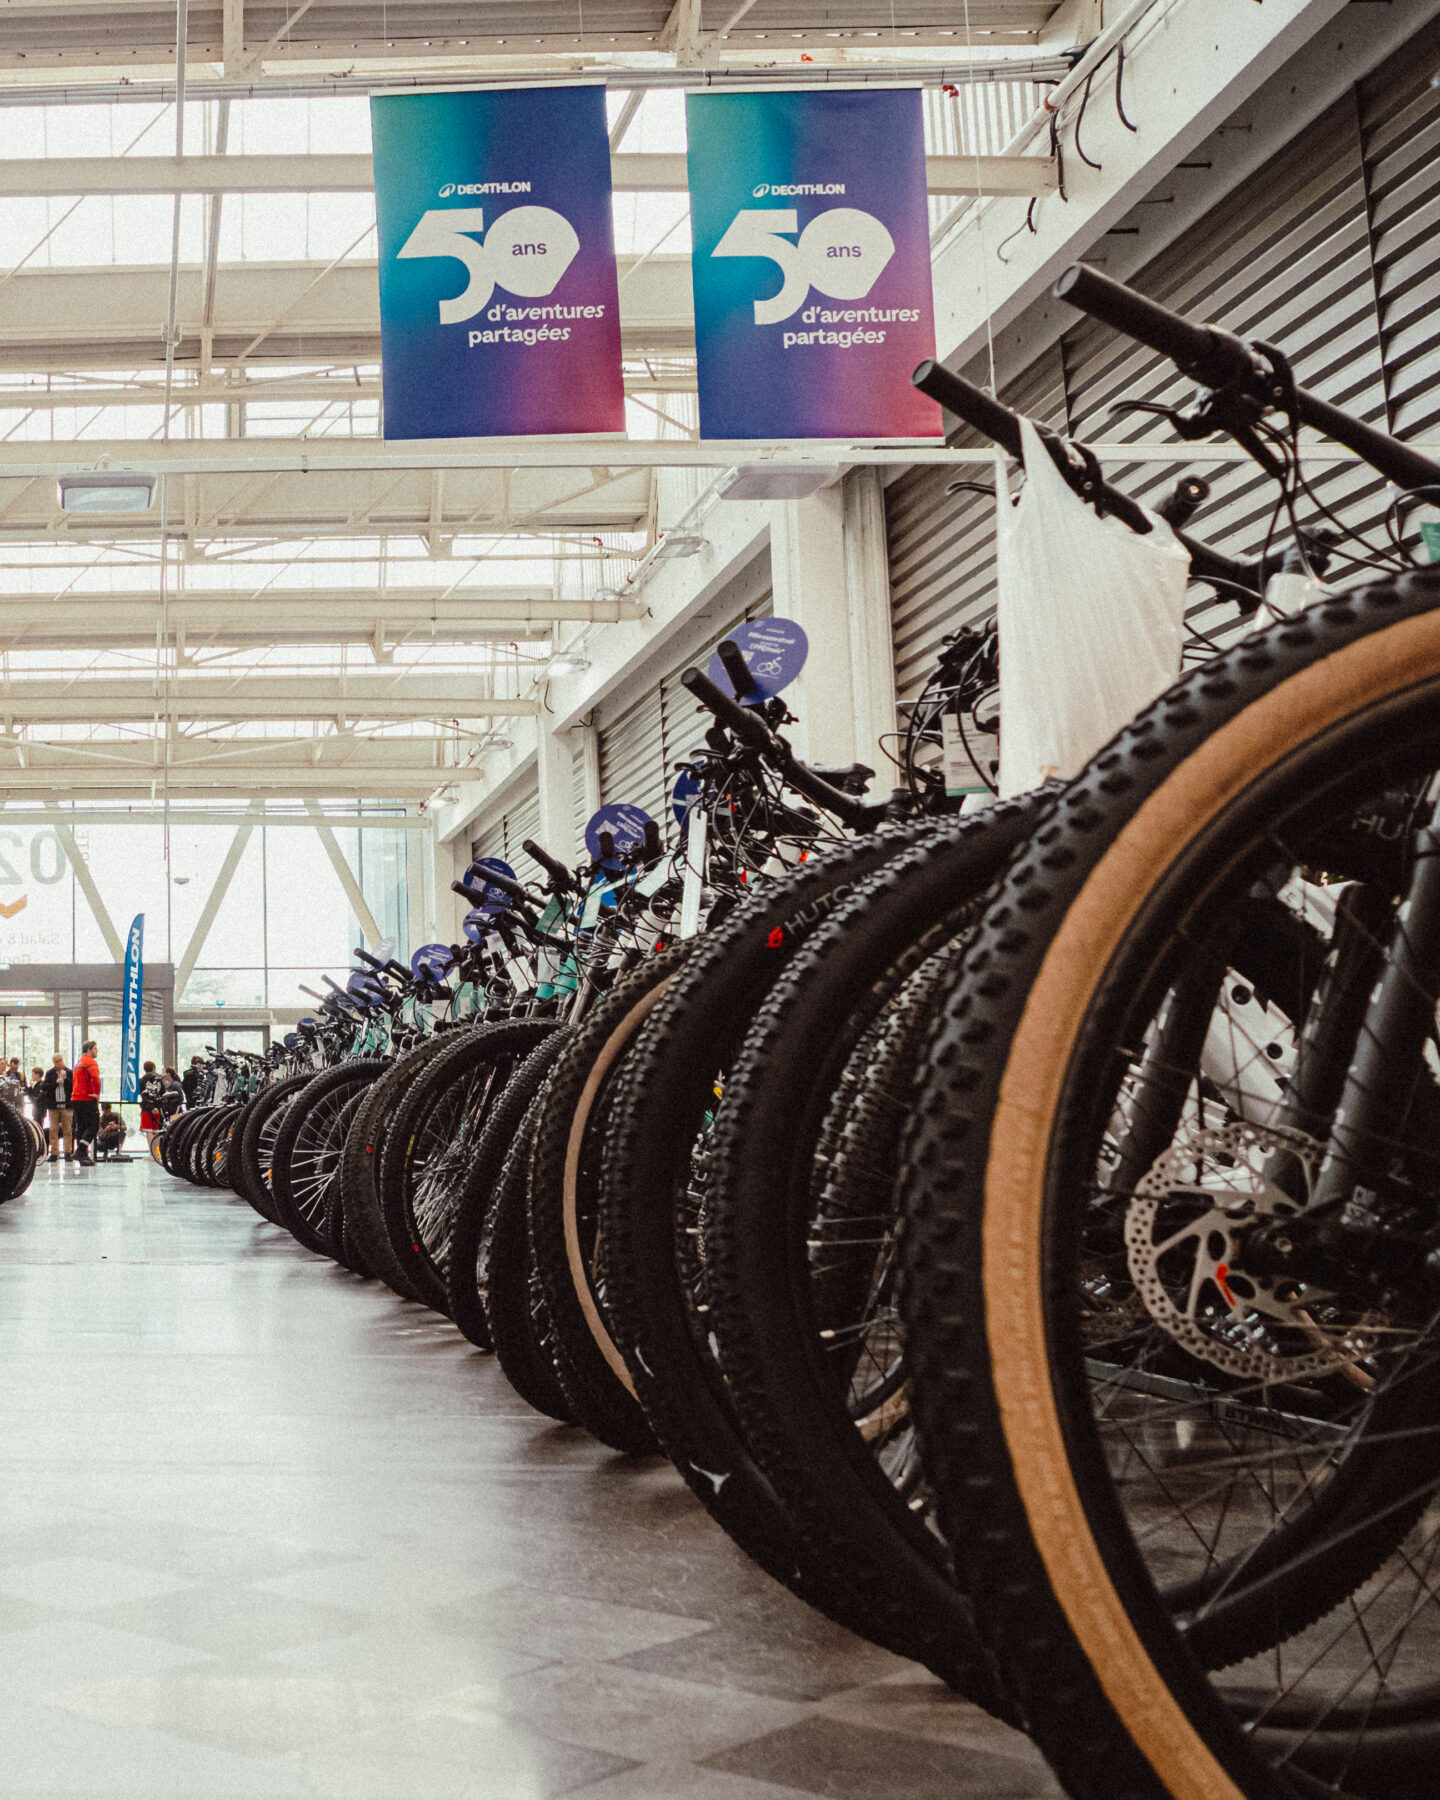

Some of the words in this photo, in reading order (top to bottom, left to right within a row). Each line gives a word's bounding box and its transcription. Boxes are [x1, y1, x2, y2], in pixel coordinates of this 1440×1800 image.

[457, 181, 531, 196] DECATHLON
[771, 182, 846, 196] DECATHLON
[511, 241, 548, 257] ans
[826, 243, 862, 259] ans
[396, 205, 581, 325] 50
[710, 207, 896, 325] 50
[486, 302, 605, 323] d'aventures
[801, 304, 920, 325] d'aventures
[468, 323, 571, 347] partagées
[783, 326, 886, 349] partagées
[127, 928, 142, 1056] DECATHLON
